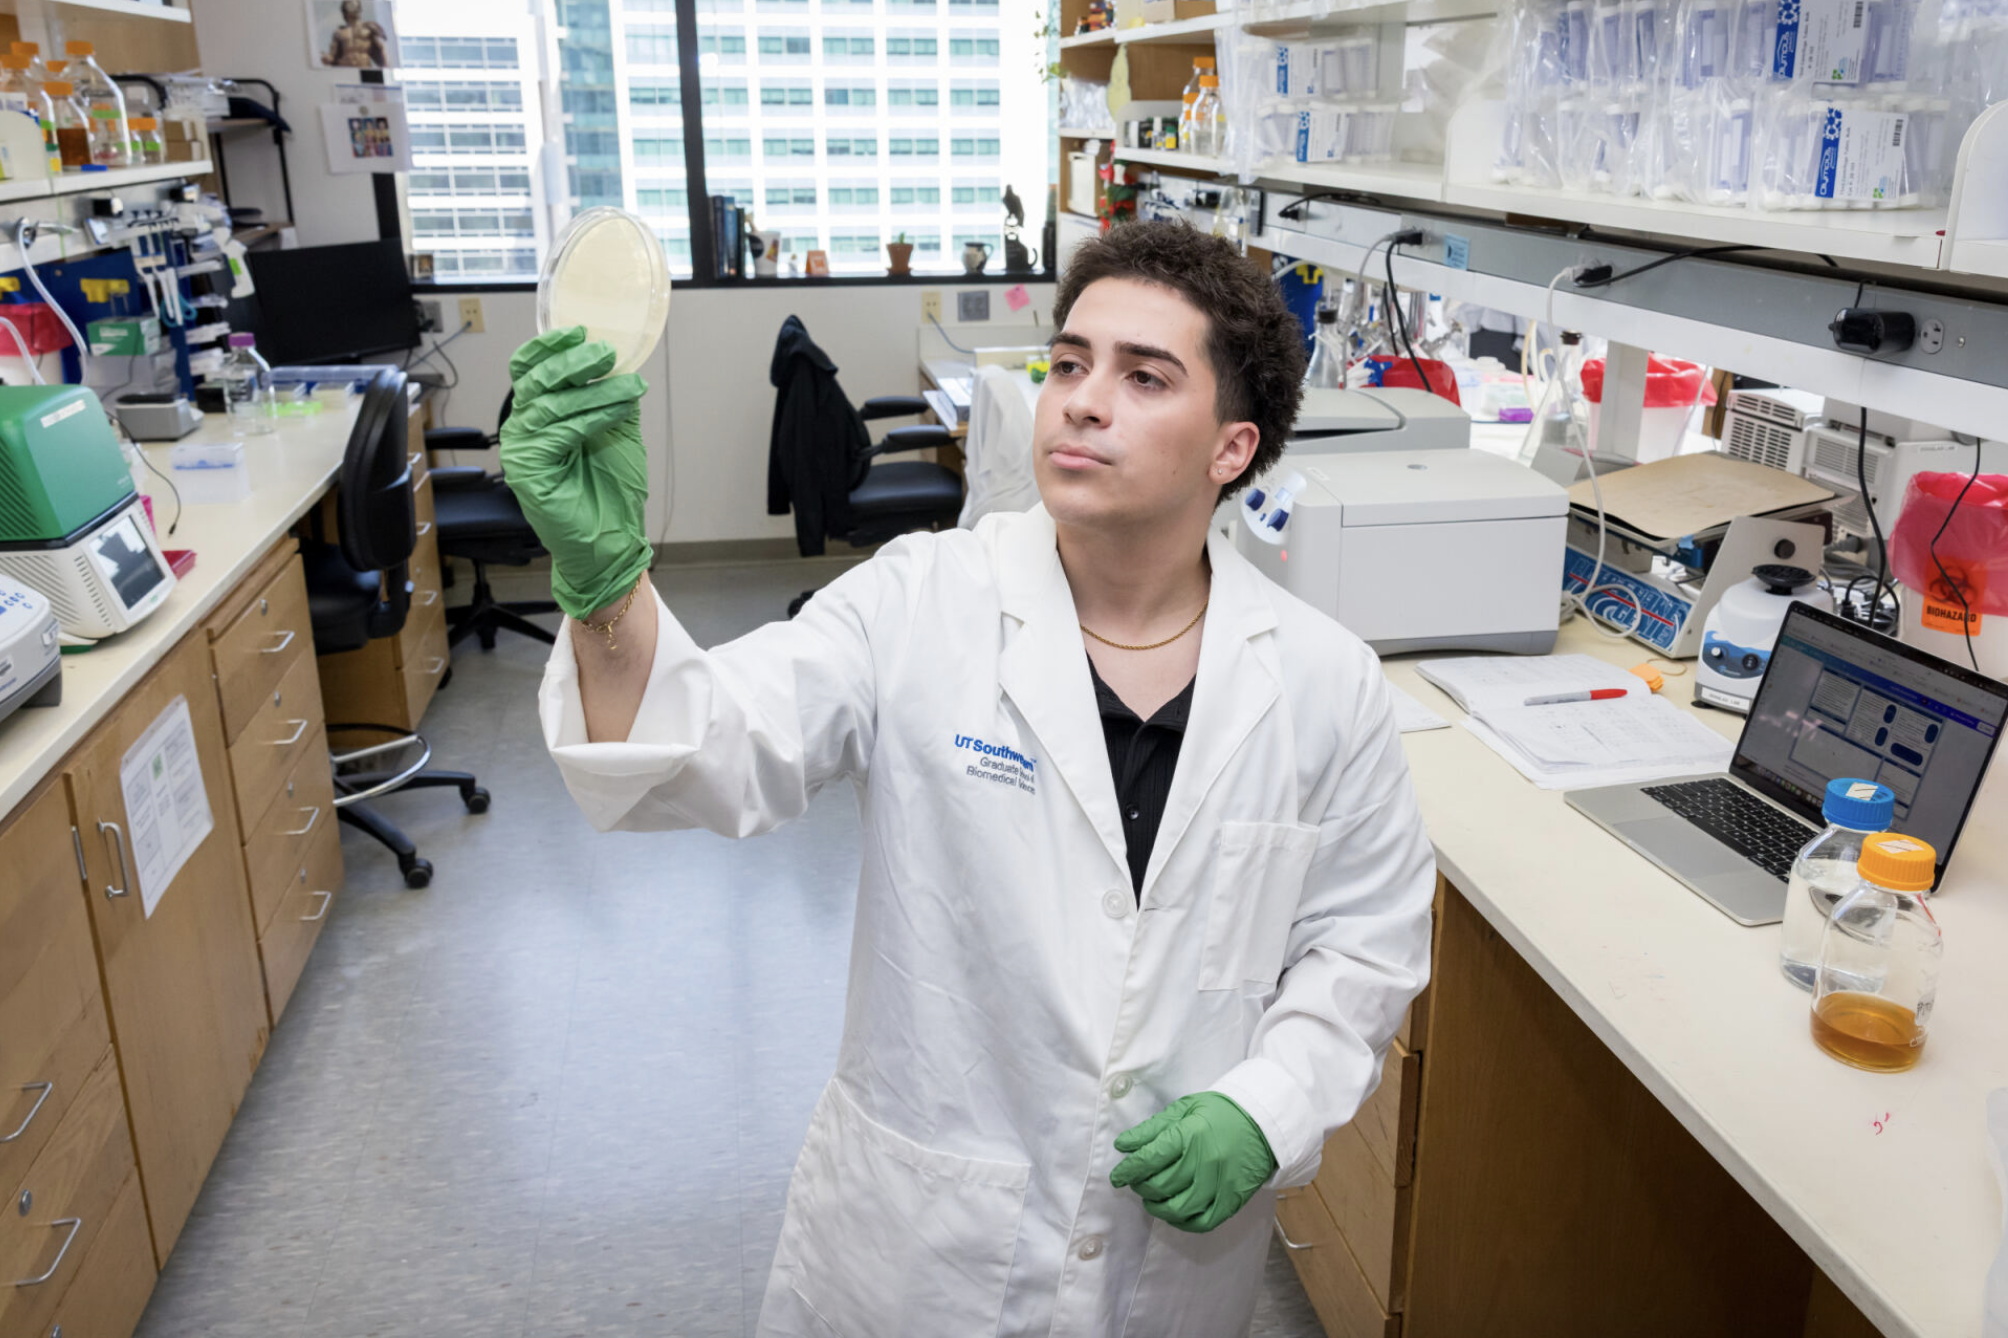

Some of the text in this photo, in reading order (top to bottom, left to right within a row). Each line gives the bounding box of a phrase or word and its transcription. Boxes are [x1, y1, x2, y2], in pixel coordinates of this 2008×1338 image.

[973, 739, 1034, 772] Southwern
[980, 756, 1019, 776] Graduate
[966, 765, 1017, 787] Biomedical
